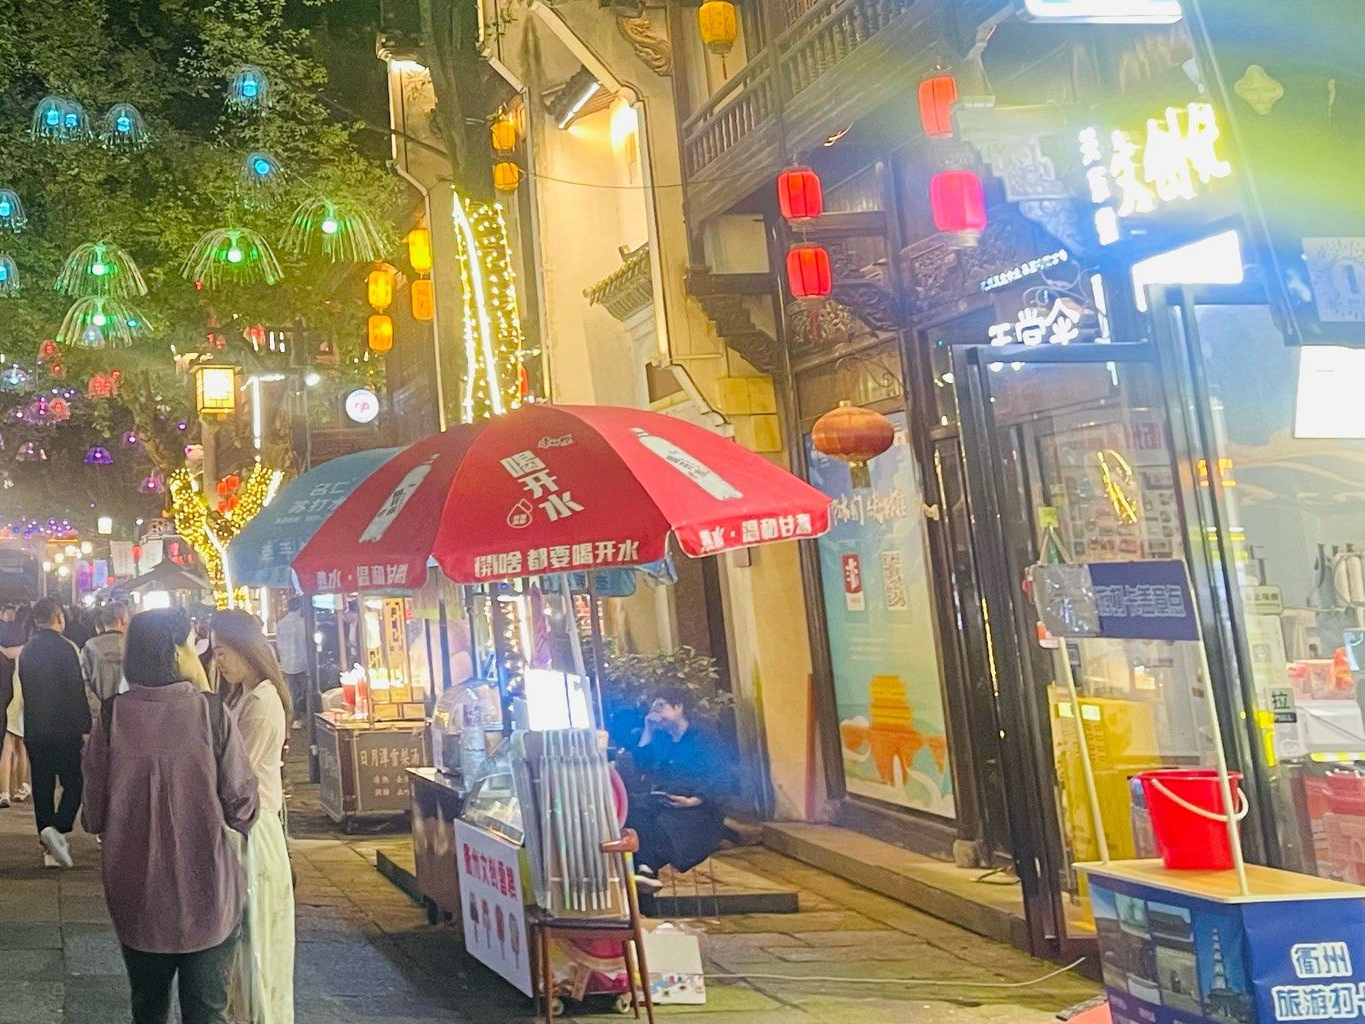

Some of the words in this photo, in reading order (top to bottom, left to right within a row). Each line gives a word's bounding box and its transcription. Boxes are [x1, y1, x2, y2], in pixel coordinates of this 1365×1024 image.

[499, 450, 585, 522] 喝开水
[527, 539, 640, 571] 都要喝开水
[1271, 691, 1290, 710] 拉
[1291, 942, 1353, 979] 衢州
